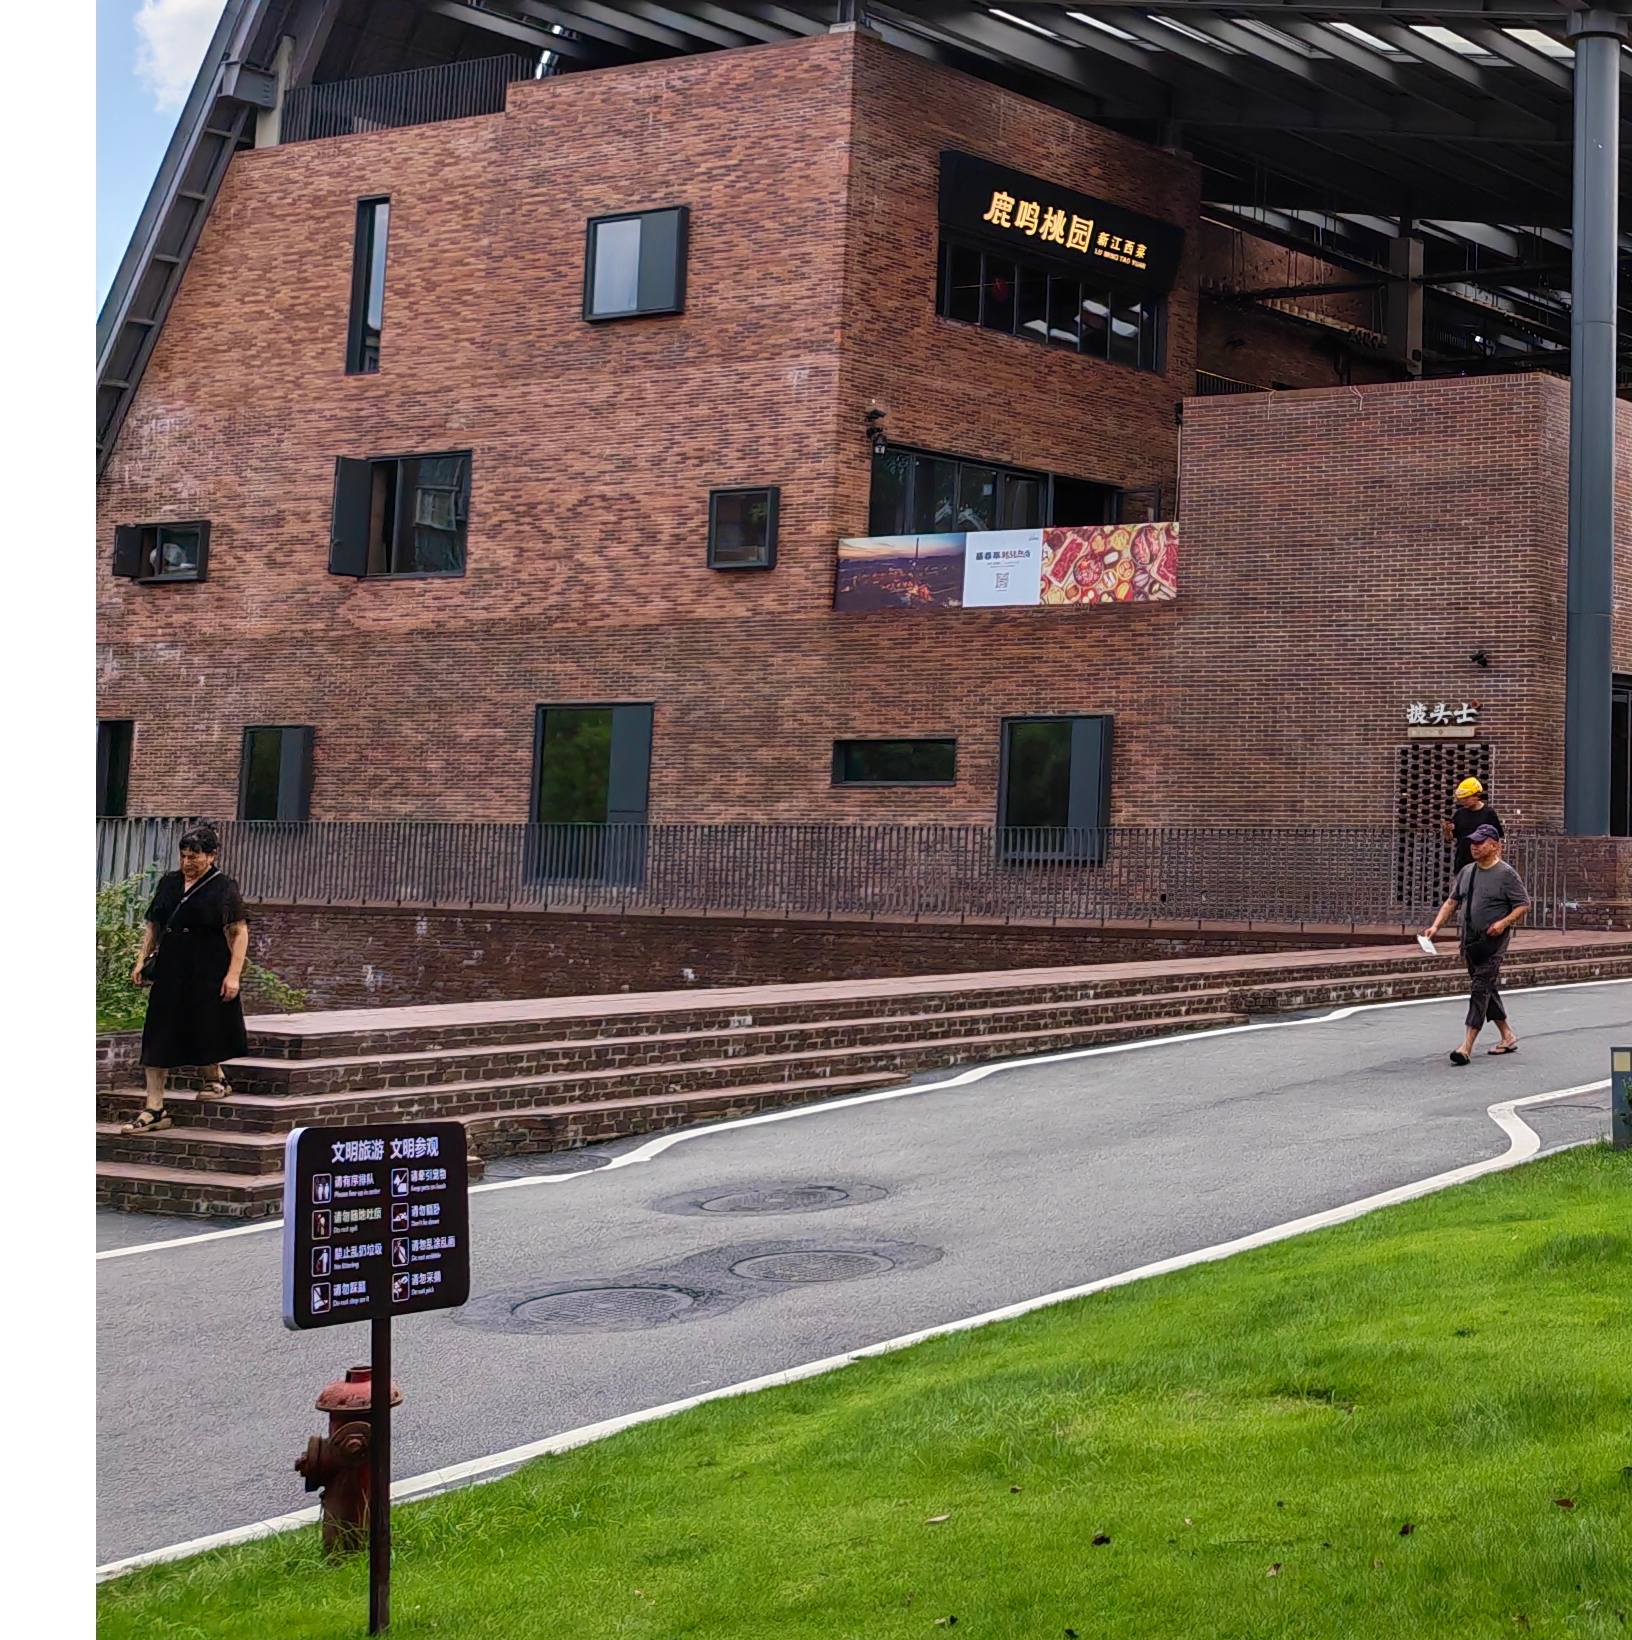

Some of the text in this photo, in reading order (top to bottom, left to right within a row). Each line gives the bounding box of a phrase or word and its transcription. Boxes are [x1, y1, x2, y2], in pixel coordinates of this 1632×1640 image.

[982, 190, 1095, 253] 鹿鸣桃园
[1097, 231, 1148, 259] 新江西菜
[1406, 701, 1479, 725] 披头士
[331, 1136, 439, 1163] 文明旅游 文明参观
[334, 1173, 375, 1188] 请有序排队
